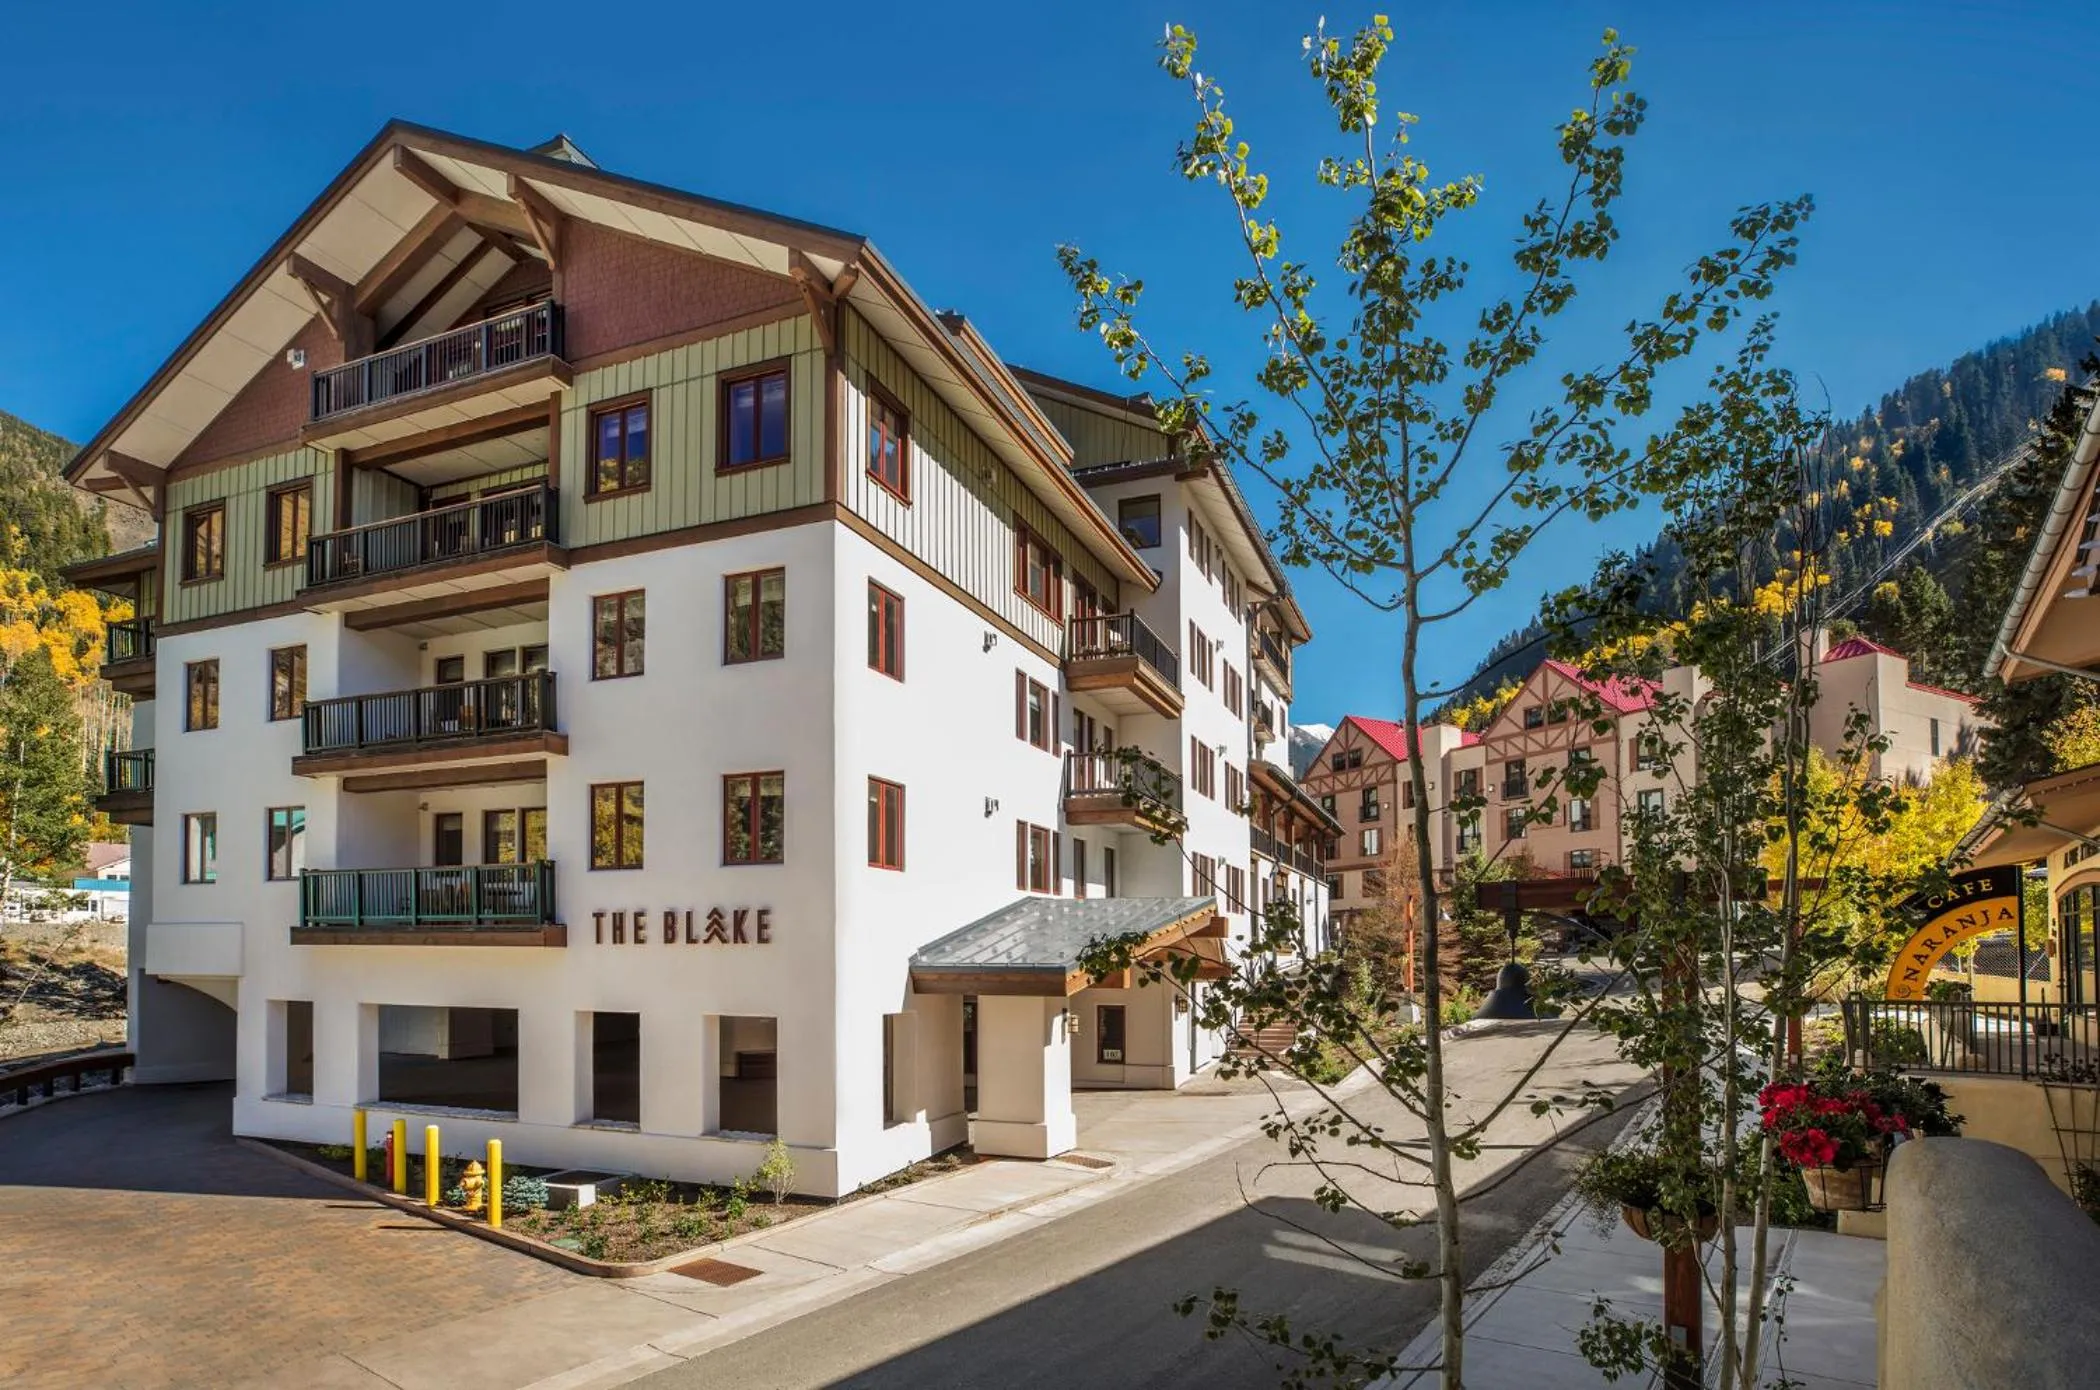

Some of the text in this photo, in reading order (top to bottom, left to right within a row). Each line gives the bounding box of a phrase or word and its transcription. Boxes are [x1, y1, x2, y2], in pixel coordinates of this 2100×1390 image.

[1928, 879, 1993, 908] CAFE
[592, 907, 771, 944] THE BLAKE
[1903, 907, 2014, 982] NARANJA
